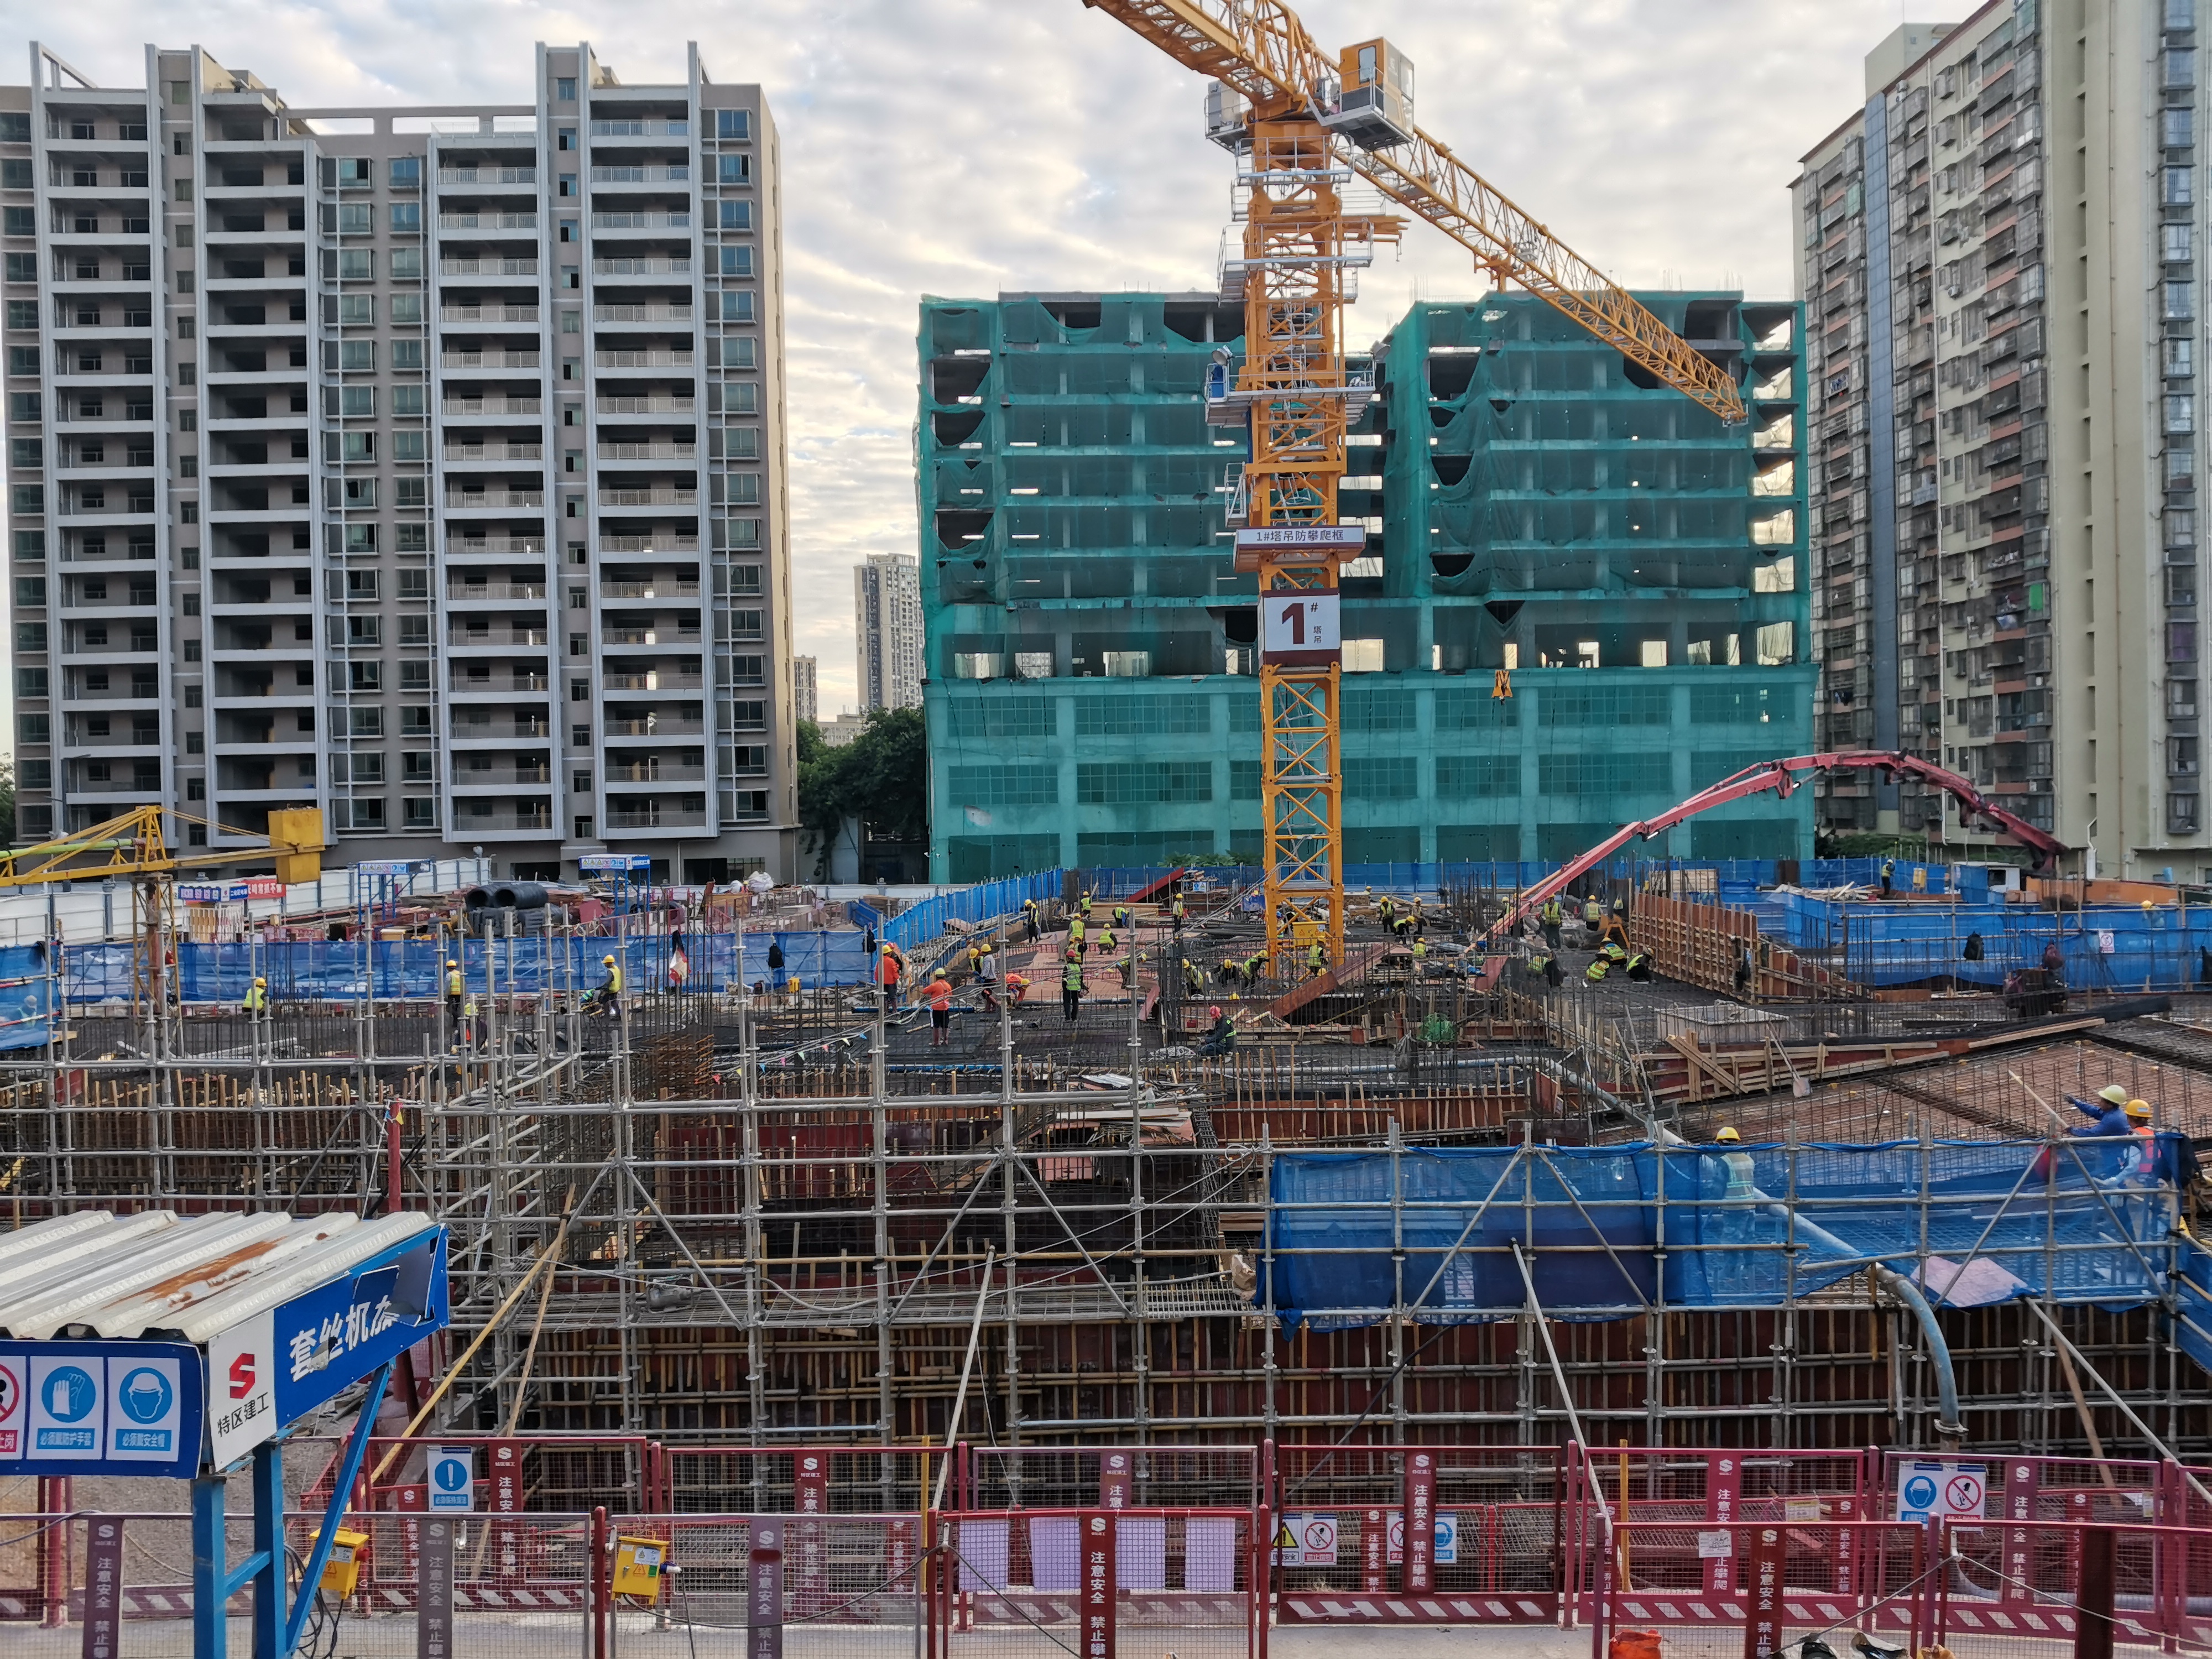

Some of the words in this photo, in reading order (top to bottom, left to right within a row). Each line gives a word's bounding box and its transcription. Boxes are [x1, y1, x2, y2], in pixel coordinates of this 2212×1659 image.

[1256, 529, 1344, 541] 1#塔吊防攀爬框
[1313, 626, 1322, 644] 塔吊
[217, 1391, 269, 1437] 特区建工
[1413, 1484, 1428, 1530] 注意安全
[95, 1557, 113, 1609] 注意安全
[429, 1556, 444, 1606] 注意安全
[1091, 1551, 1106, 1604] 注意安全
[1412, 1541, 1426, 1587] 禁止攀爬
[1759, 1561, 1776, 1610] 注意安全
[757, 1563, 773, 1616] 注意安全
[428, 1618, 444, 1659] 禁止攀
[1091, 1615, 1107, 1659] 禁止攀
